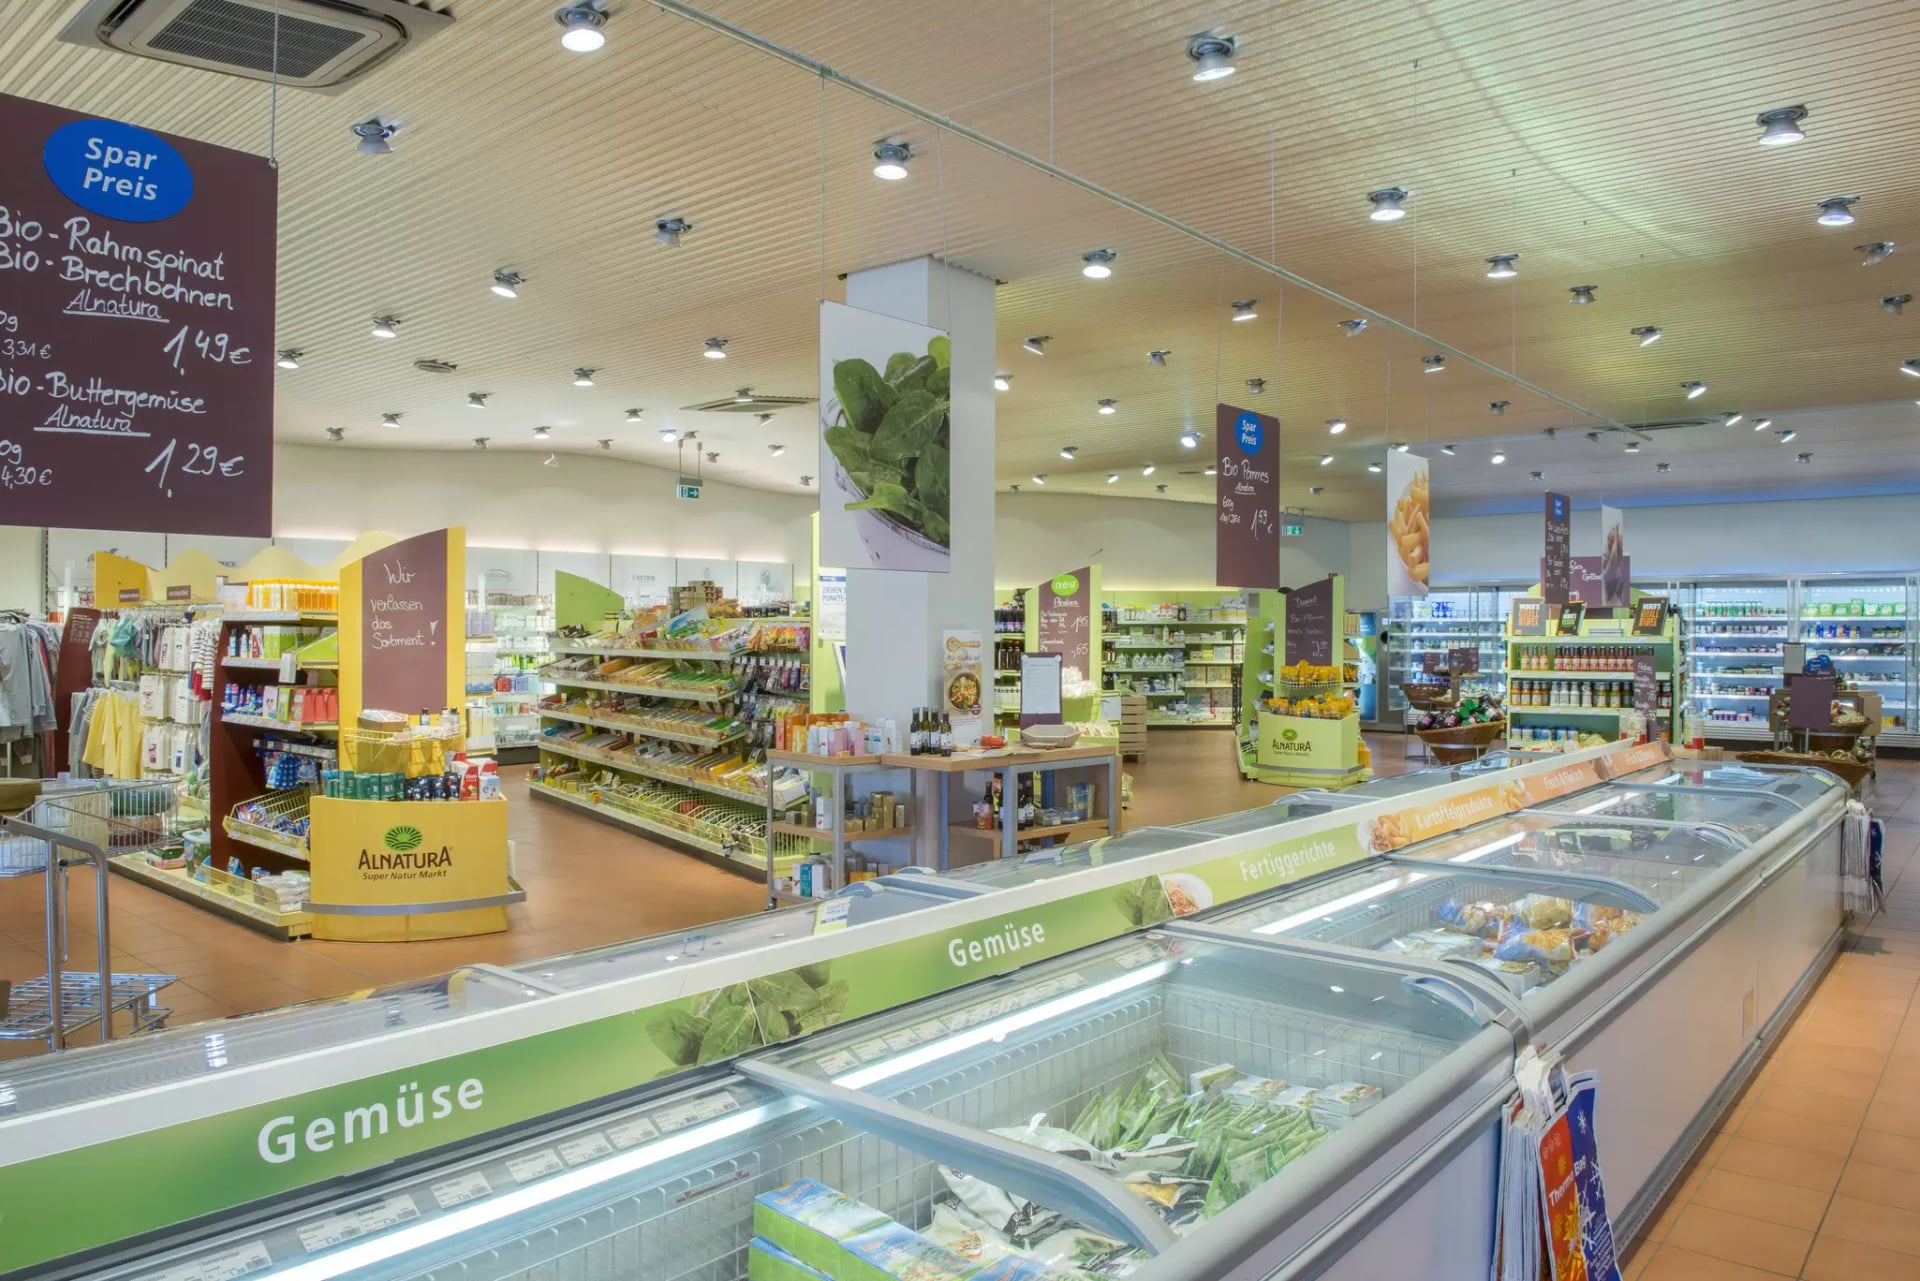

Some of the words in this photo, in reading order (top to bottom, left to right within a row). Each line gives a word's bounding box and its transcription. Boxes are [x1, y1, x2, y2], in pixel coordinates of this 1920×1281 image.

[85, 137, 157, 170] Spar
[83, 167, 157, 200] Preis
[66, 288, 163, 319] Alnatura
[44, 403, 132, 433] Alnatura
[1241, 419, 1257, 433] Spar
[1241, 433, 1257, 446] Preis
[1222, 456, 1239, 477] Bio
[383, 560, 416, 585] Wir
[1055, 580, 1076, 589] neu
[371, 614, 393, 631] das
[1272, 738, 1312, 752] ALNATURA
[358, 845, 452, 870] ALNATURA
[1240, 838, 1336, 881] Fertiggerichte
[362, 872, 388, 882] Super
[390, 872, 416, 880] Natur
[419, 870, 446, 879] Markt
[948, 920, 1046, 967] Gemüse
[257, 1077, 484, 1164] Gemüse
